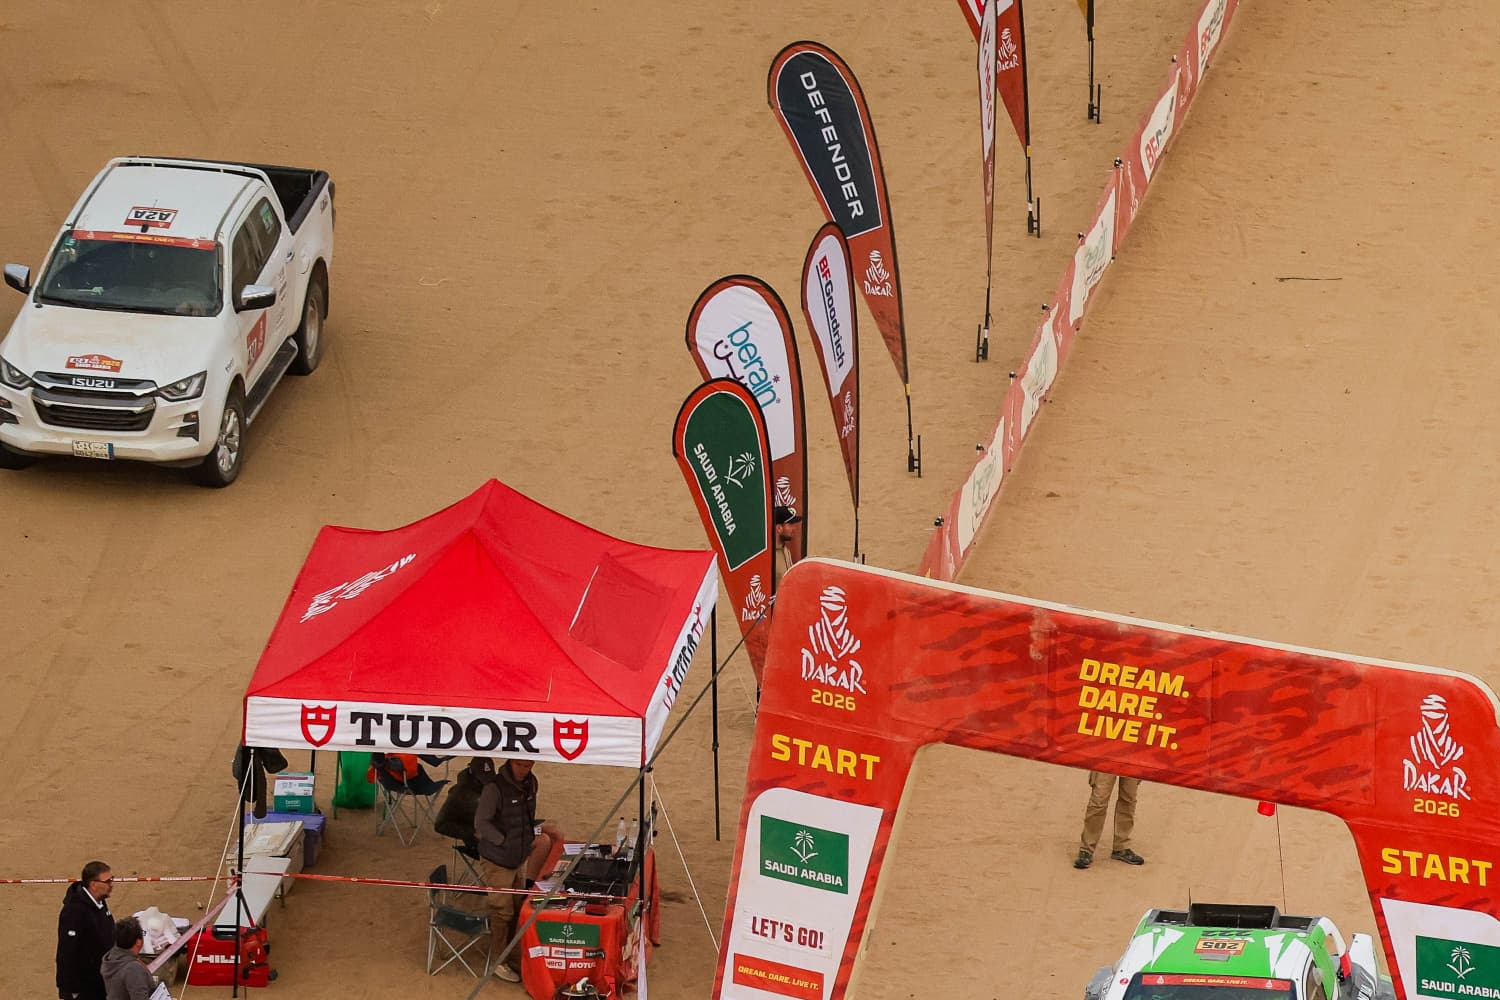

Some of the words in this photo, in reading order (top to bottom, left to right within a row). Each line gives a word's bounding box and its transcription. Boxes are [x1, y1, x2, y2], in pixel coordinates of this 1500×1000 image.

[800, 71, 864, 220] DEFENDER
[864, 279, 893, 297] DAKAR
[818, 255, 846, 369] BFGoodrich
[72, 377, 114, 388] ISUZU
[727, 321, 777, 409] berain
[693, 443, 717, 479] SAUDI
[712, 484, 736, 536] ARABIA
[801, 647, 867, 695] DAKAR
[1079, 658, 1190, 698] DREAM.
[811, 688, 856, 711] 2026
[1078, 685, 1163, 720] DARE.
[350, 711, 539, 754] TUDOR
[1077, 712, 1142, 744] LIVE
[1145, 722, 1178, 750] IT.
[771, 734, 881, 780] START
[1403, 758, 1471, 801] DAKAR
[1413, 798, 1460, 818] 2026
[764, 858, 799, 878] SAUDI
[800, 866, 843, 887] ARABIA
[1381, 847, 1493, 887] START
[798, 926, 824, 951] GO!
[1202, 942, 1239, 950] 205
[738, 965, 767, 979] DREAM.
[768, 972, 791, 984] DARE.
[792, 976, 809, 988] LIVE
[809, 980, 820, 991] IT.
[1421, 979, 1456, 994] SAUDI
[1457, 983, 1500, 1000] ARABIA
